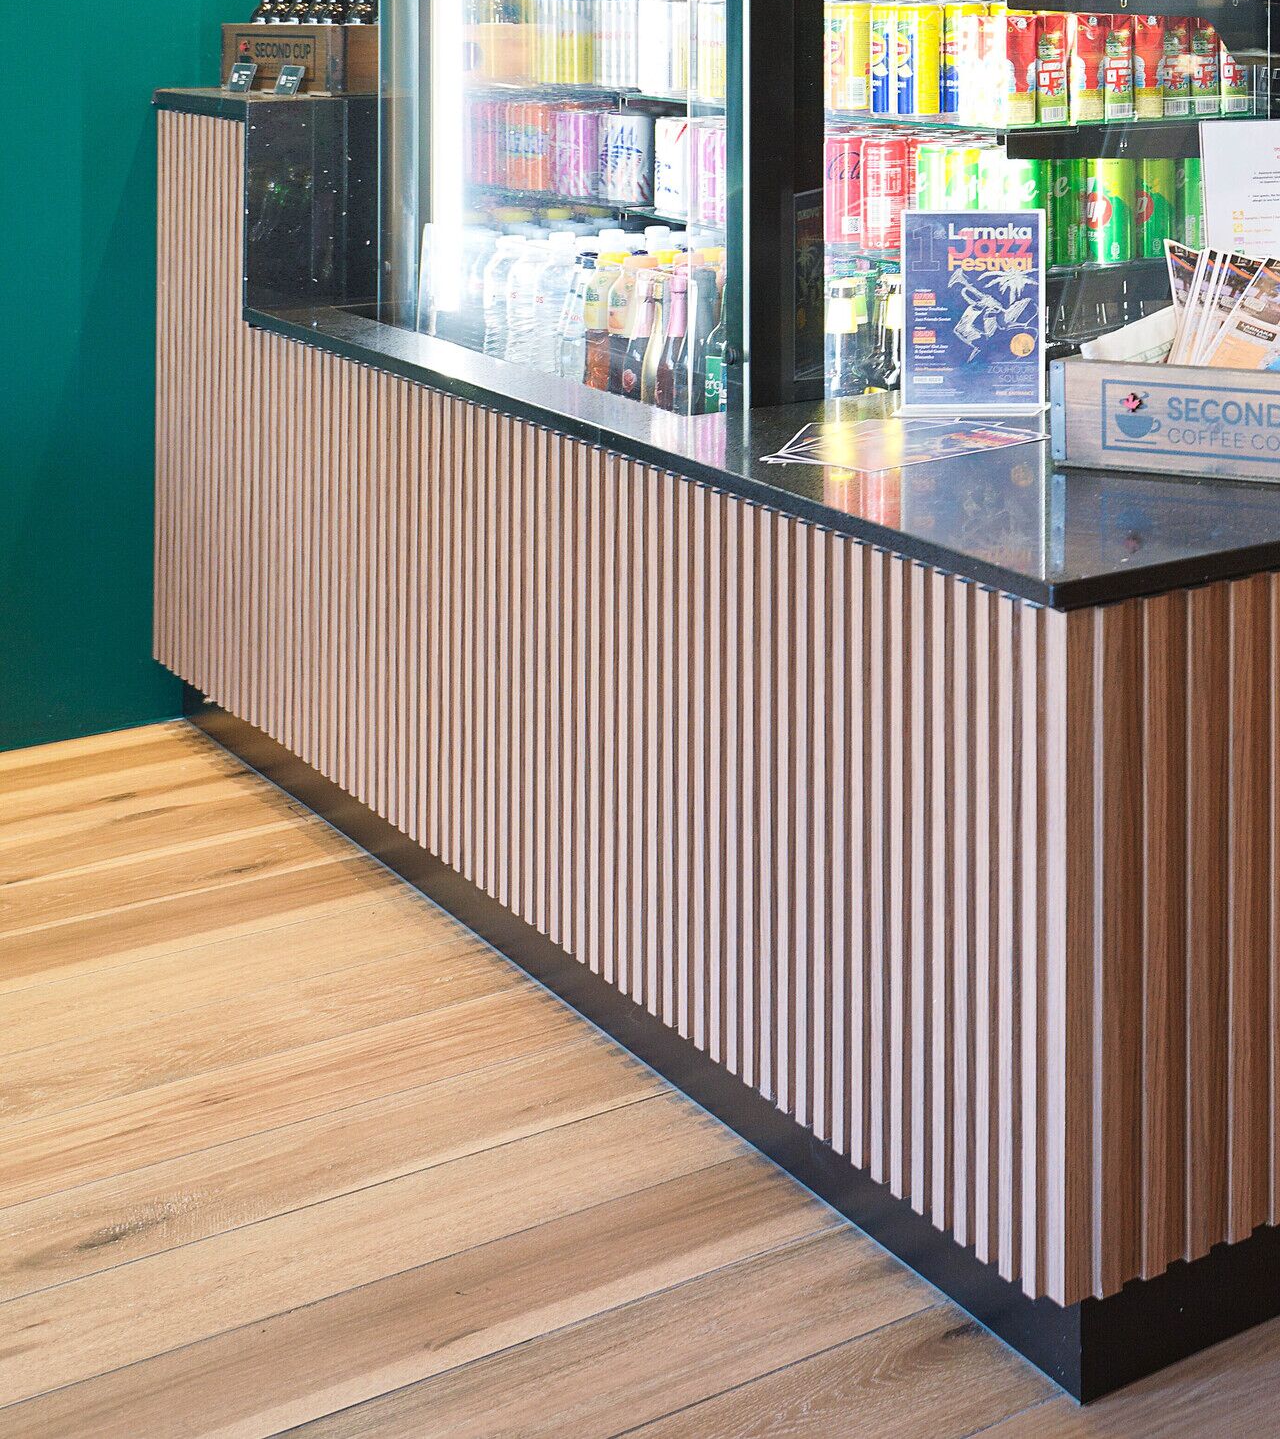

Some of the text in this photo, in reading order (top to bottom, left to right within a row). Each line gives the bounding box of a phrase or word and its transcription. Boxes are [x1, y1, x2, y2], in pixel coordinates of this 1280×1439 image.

[255, 42, 311, 60] SECOND CUP
[949, 223, 1033, 240] Larnaka
[948, 230, 1033, 259] Jazz
[948, 253, 1033, 271] Festival
[1167, 427, 1245, 449] COFFEE
